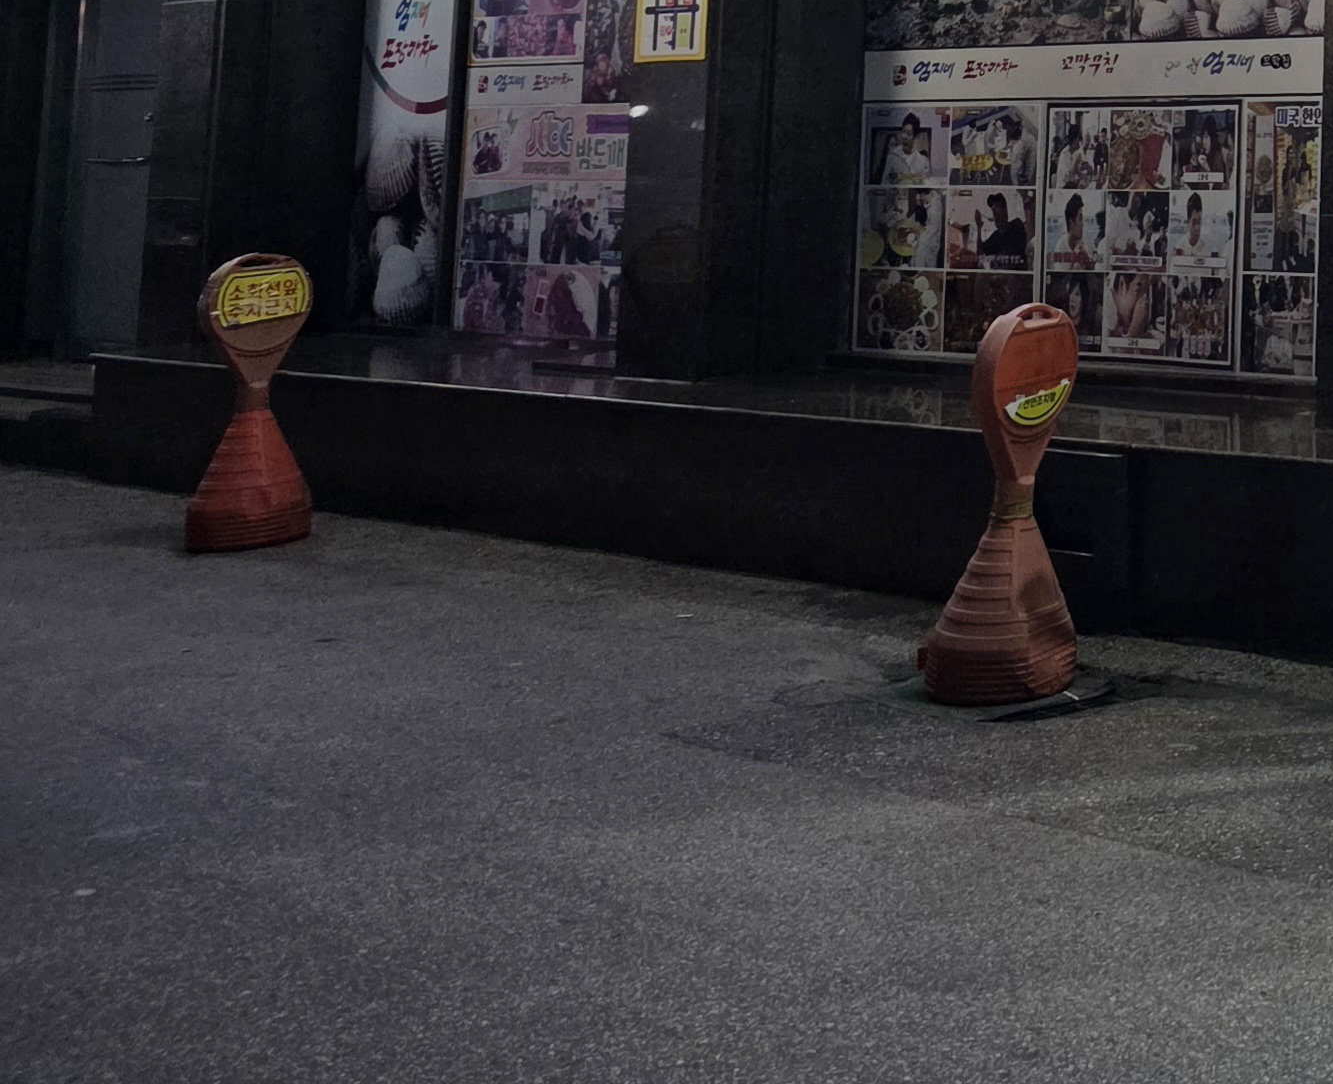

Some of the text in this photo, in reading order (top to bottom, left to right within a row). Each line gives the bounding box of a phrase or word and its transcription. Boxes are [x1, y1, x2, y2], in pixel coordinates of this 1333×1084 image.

[381, 34, 438, 68] 포장마차
[1202, 50, 1255, 74] 엄지네
[912, 61, 955, 82] 엄지네
[963, 58, 1019, 79] 포장마차
[1061, 52, 1119, 77] 꼬막무침
[1277, 108, 1299, 127] 미국
